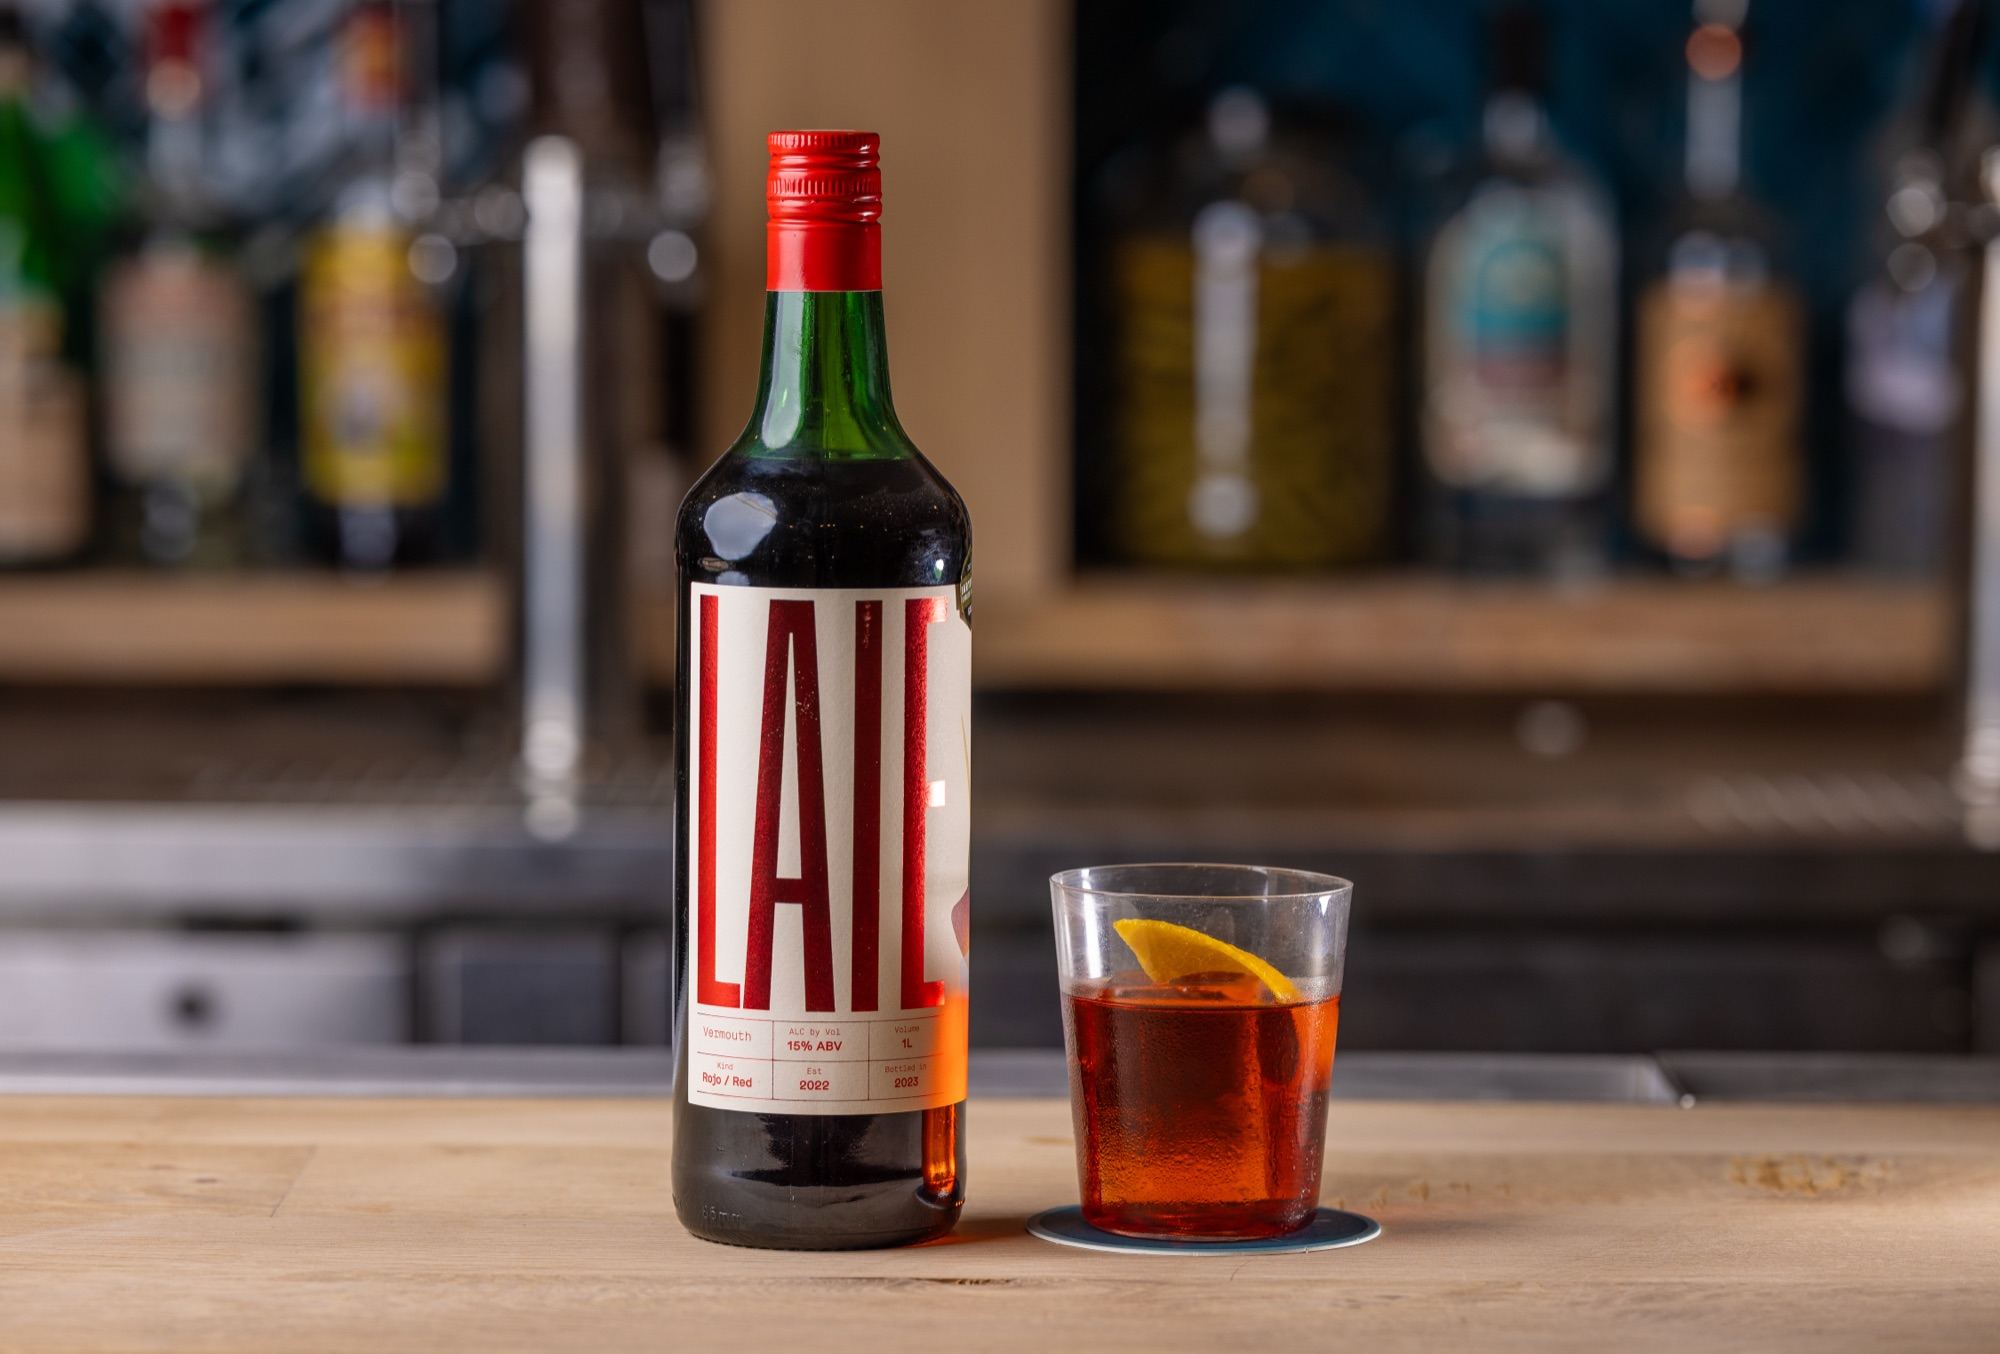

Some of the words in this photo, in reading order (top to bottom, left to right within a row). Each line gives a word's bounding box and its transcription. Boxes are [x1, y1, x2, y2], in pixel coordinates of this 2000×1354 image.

[703, 1025, 752, 1041] Vermouth
[810, 1028, 820, 1037] by
[825, 1028, 841, 1036] Vol
[894, 1025, 920, 1033] Volume
[787, 1041, 812, 1051] 15%
[816, 1041, 843, 1051] ABV
[901, 1038, 912, 1048] 1L
[717, 1062, 733, 1070] Kind
[807, 1067, 822, 1075] Est
[884, 1064, 915, 1073] Bottled
[702, 1071, 722, 1086] Rojo
[732, 1076, 752, 1088] Red
[894, 1076, 919, 1088] 2023
[799, 1080, 830, 1091] 2022
